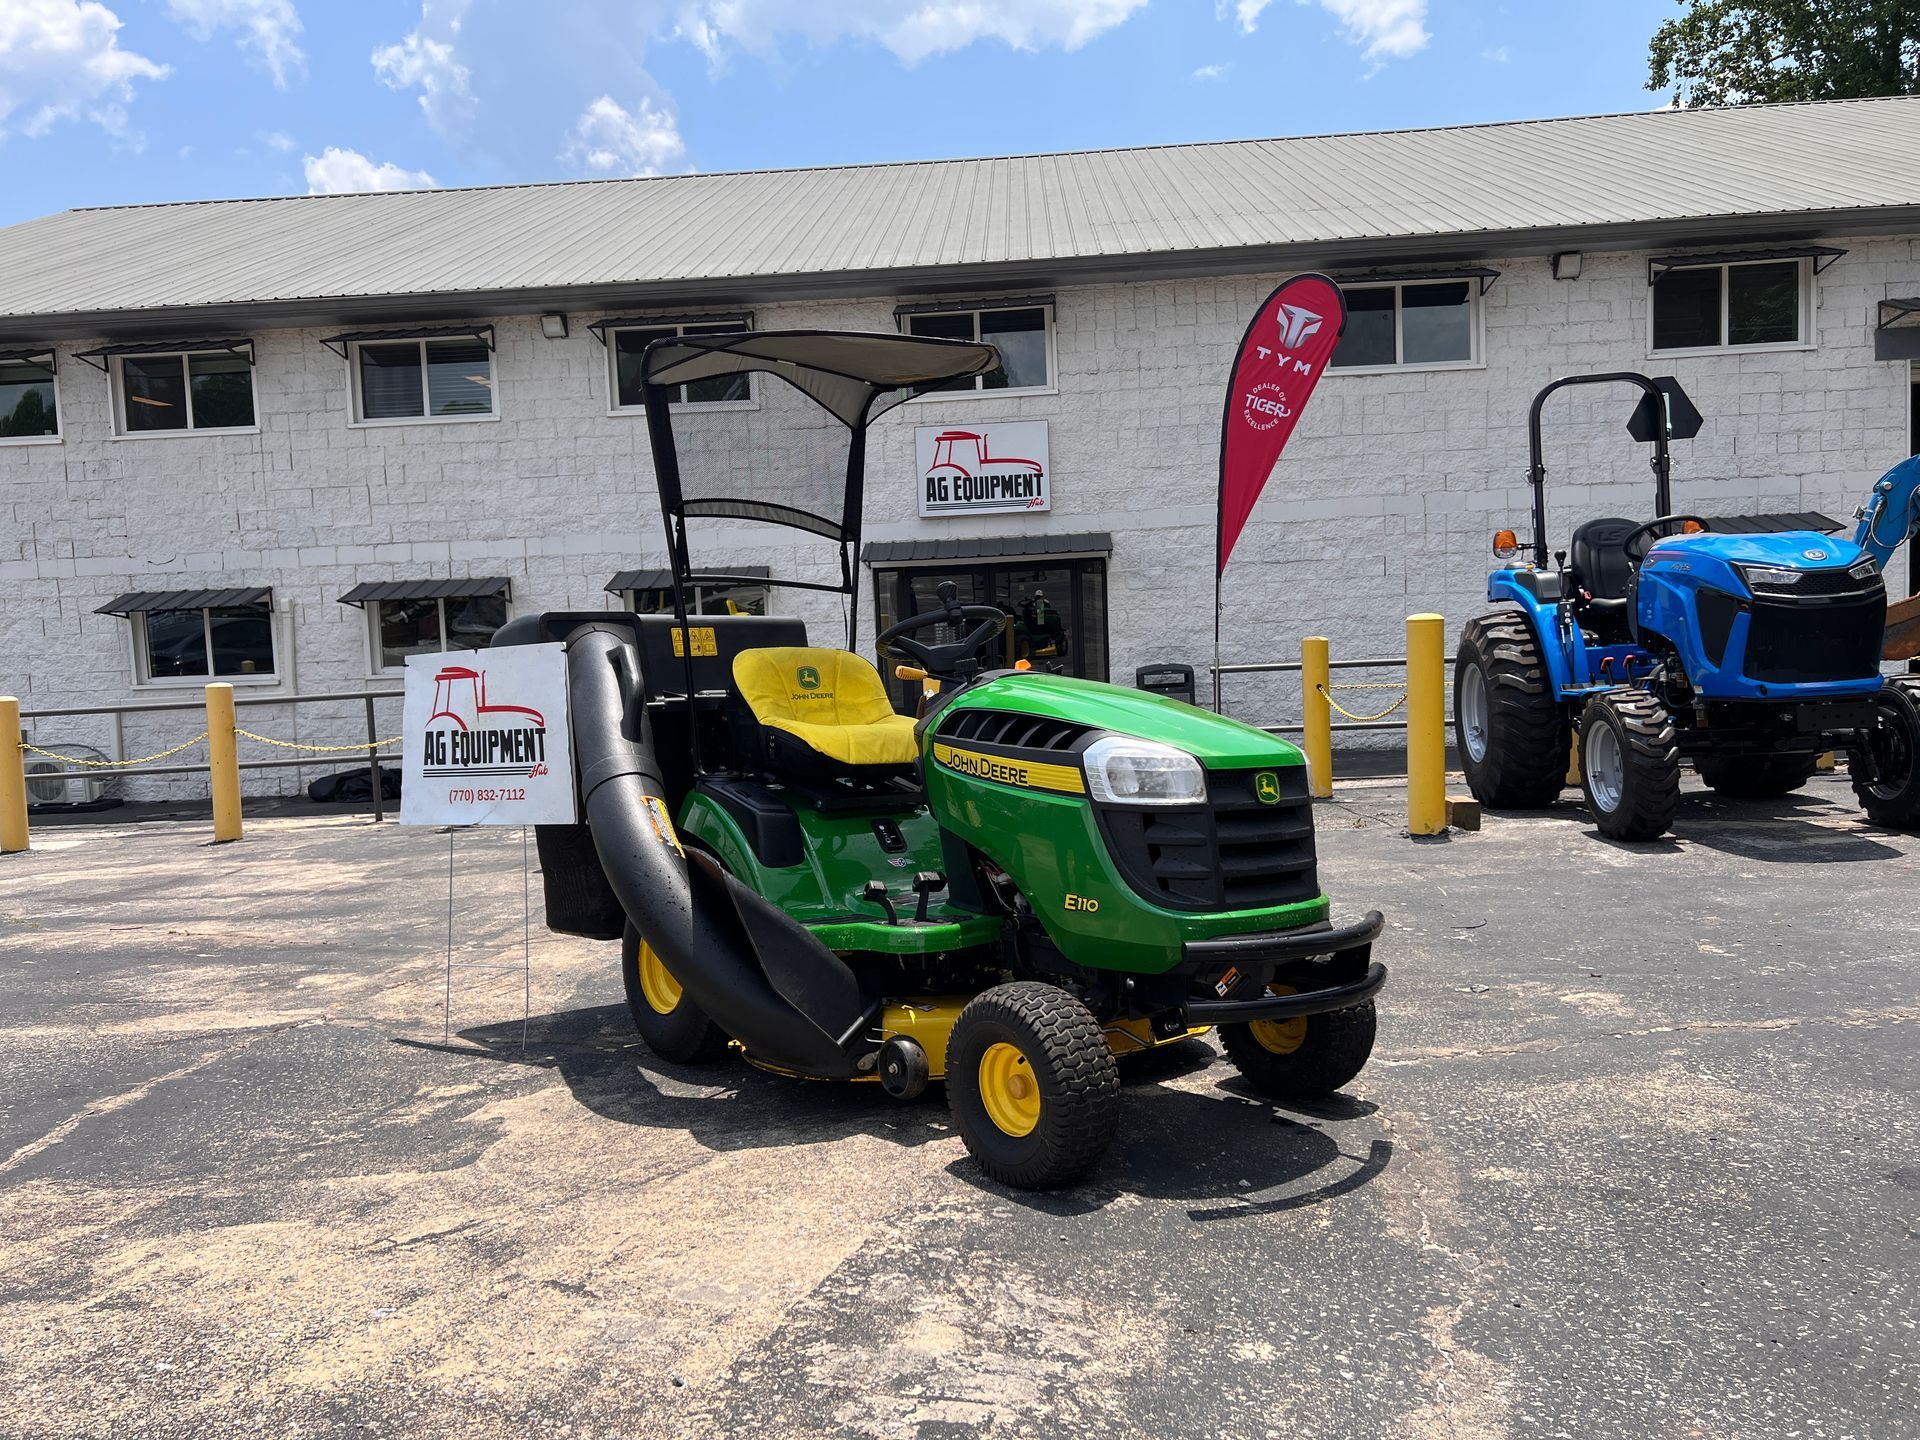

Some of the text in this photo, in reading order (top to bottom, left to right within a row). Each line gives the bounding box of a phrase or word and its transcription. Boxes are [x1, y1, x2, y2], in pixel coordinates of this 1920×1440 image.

[1256, 345, 1312, 376] TYM
[1252, 382, 1287, 402] DEALER OF
[1245, 393, 1291, 418] TIGER
[1243, 409, 1280, 431] EXCELLENCE
[926, 472, 1044, 503] AG EQUIPMENT
[1025, 497, 1045, 509] Hub
[423, 727, 546, 767] AG EQUIPMENT
[528, 763, 548, 779] Hub
[947, 749, 1029, 785] JOHN DEERE
[449, 788, 525, 804] (770) 832-7112
[1064, 893, 1099, 913] E110
